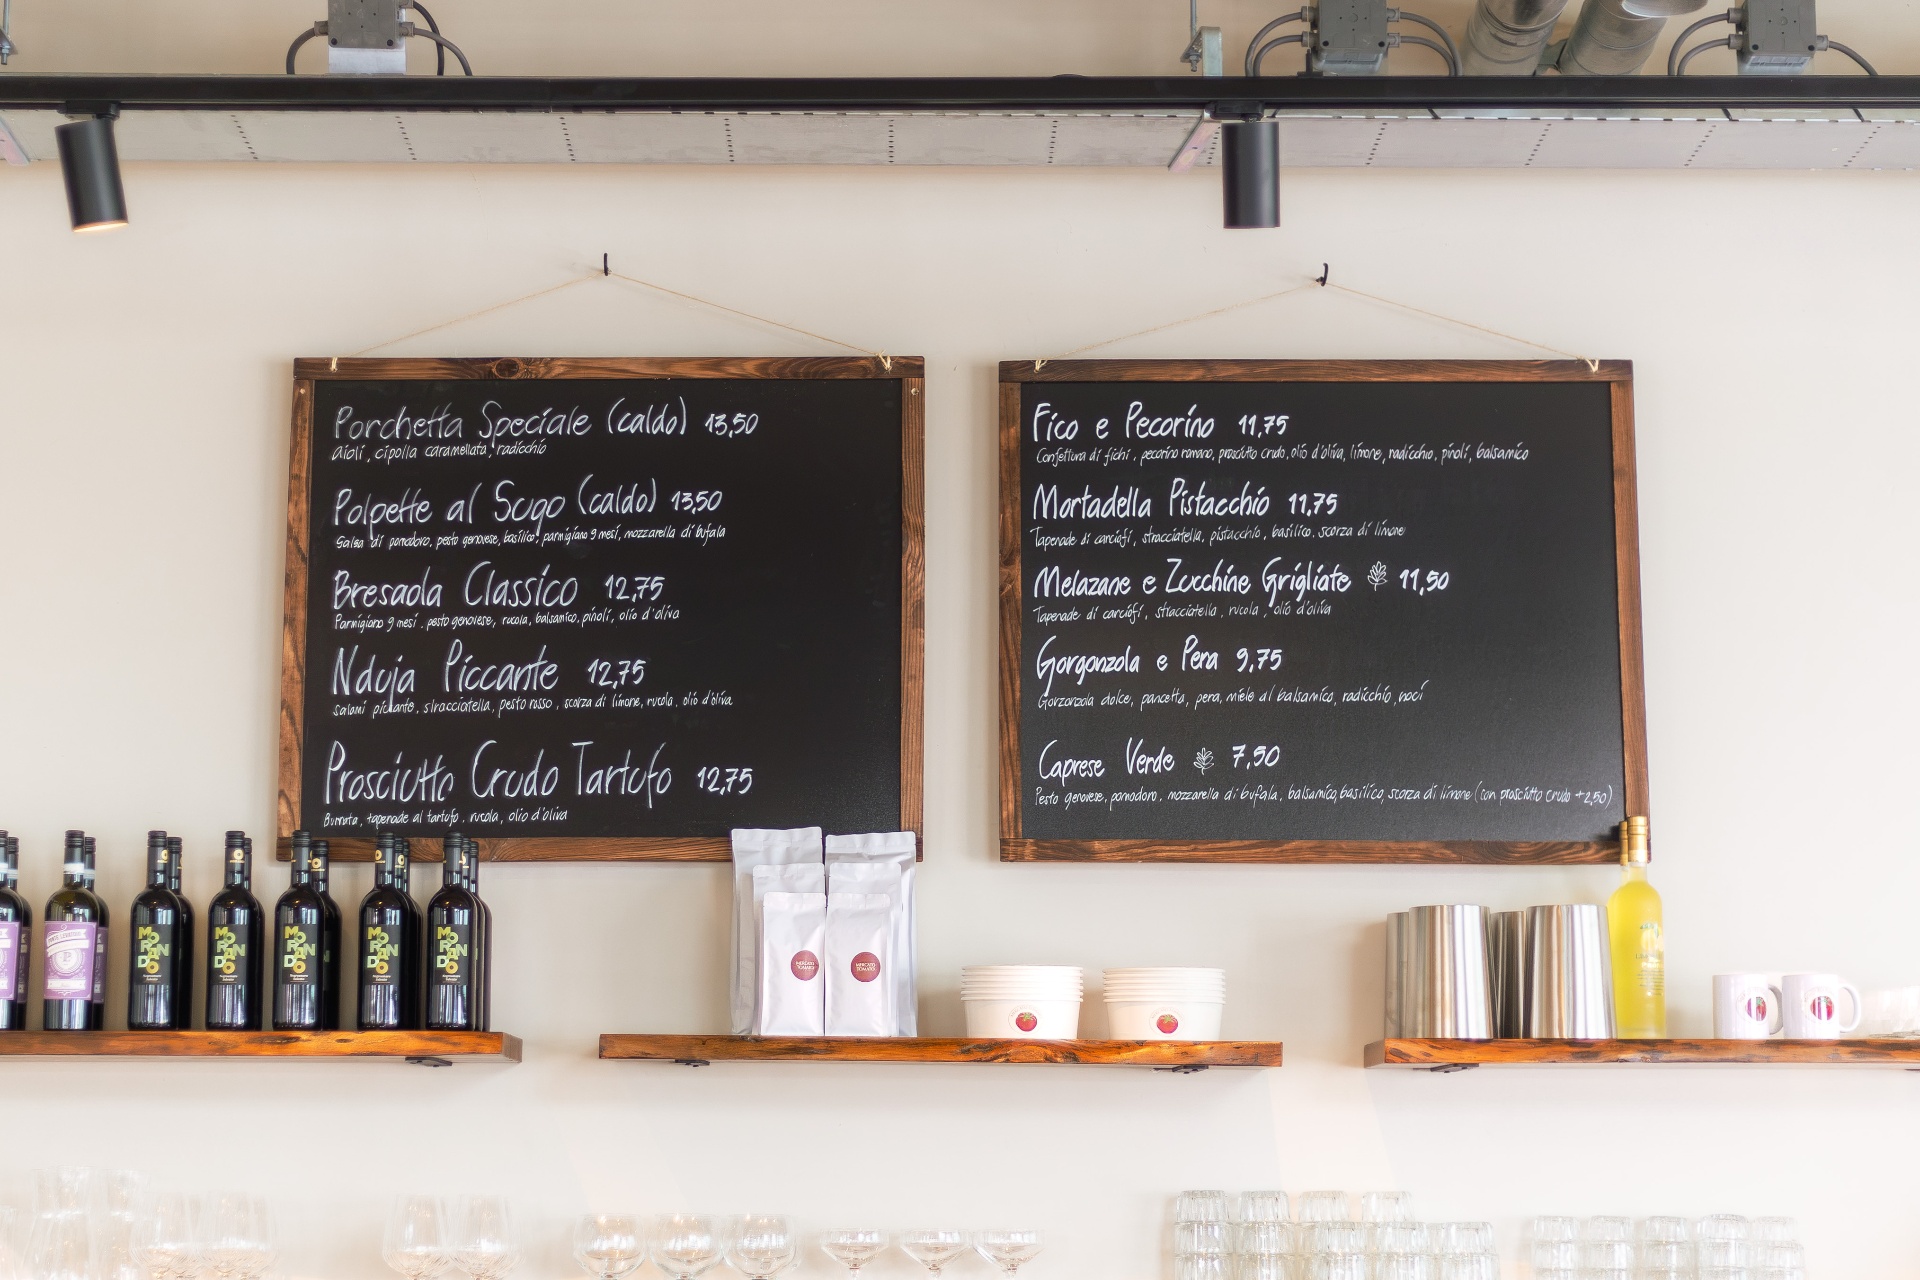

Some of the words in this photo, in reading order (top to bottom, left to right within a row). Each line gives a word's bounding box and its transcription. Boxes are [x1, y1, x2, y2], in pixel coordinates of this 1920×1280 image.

[335, 402, 462, 439] Porchetta
[479, 400, 592, 447] Speciale
[608, 396, 686, 435] (caldo)
[705, 413, 758, 437] 13,50
[1033, 402, 1079, 442] Fico
[1096, 418, 1109, 439] e
[1125, 401, 1215, 438] Pecorino
[1238, 414, 1289, 439] 11,75
[375, 445, 417, 465] cipolla
[496, 439, 547, 456] radicchio
[1036, 447, 1086, 467] Confettura
[1089, 447, 1102, 461] di
[1140, 445, 1178, 466] pecorino
[1218, 445, 1258, 464] prosciutto
[1290, 443, 1308, 459] olio
[1476, 441, 1529, 460] balsamico
[334, 488, 432, 540] Polpette
[447, 483, 482, 523] al
[494, 480, 565, 537] Sugo
[578, 473, 656, 514] (caldo)
[671, 490, 723, 514] 13,50
[1033, 483, 1151, 519] Mortadella
[1169, 477, 1270, 517] Pistacchio
[1288, 492, 1338, 517] 11,75
[371, 535, 384, 548] di
[435, 532, 458, 550] pesto
[542, 526, 587, 547] parmigiano
[590, 528, 597, 540] 9
[624, 525, 676, 539] mozzarella
[680, 523, 695, 538] di
[695, 523, 726, 547] bufala
[1029, 526, 1077, 552] Tapenade
[1081, 532, 1091, 546] di
[1318, 526, 1353, 538] scorza
[1357, 521, 1373, 536] di
[1374, 519, 1406, 537] limone
[333, 566, 443, 610] Bresaola
[464, 560, 578, 608] Classico
[605, 574, 667, 603] 12,75
[1034, 565, 1131, 598] Melazane
[1143, 575, 1156, 594] e
[1165, 558, 1251, 594] Zucchine
[1262, 556, 1351, 607] Grigliate
[1399, 568, 1450, 596] 11,50
[335, 613, 384, 633] Parmigiano
[426, 614, 450, 631] pesto
[619, 607, 638, 621] olio
[642, 605, 680, 621] d'oliva
[1033, 605, 1081, 626] Tapenade
[1086, 606, 1099, 620] di
[1274, 601, 1291, 616] olio
[1296, 599, 1331, 616] d'oliva
[442, 638, 559, 692] Piccante
[587, 658, 647, 690] 12,75
[1036, 635, 1140, 697] Gorgonzola
[1157, 655, 1168, 672] e
[1182, 635, 1219, 672] Pera
[1236, 647, 1282, 673] 9,75
[333, 700, 367, 717] salami
[498, 696, 526, 718] pesto
[564, 697, 592, 709] scorza
[595, 694, 606, 708] di
[683, 691, 698, 706] olio
[702, 690, 733, 706] d'oliva
[1226, 686, 1254, 702] miele
[1259, 684, 1276, 701] al
[1398, 680, 1429, 702] noci
[324, 740, 454, 804] Prosciutto
[472, 740, 559, 797] Crudo
[571, 740, 672, 809] Tartufo
[697, 766, 753, 795] 12,75
[1039, 739, 1105, 786] Caprese
[1126, 737, 1175, 774] Verde
[1232, 744, 1280, 770] 7,50
[1035, 786, 1058, 805] Pesto
[1168, 787, 1219, 800] mozzarella
[1224, 787, 1238, 800] di
[1388, 787, 1420, 800] scorza
[1423, 782, 1437, 800] di
[1440, 784, 1473, 800] limone
[1474, 780, 1496, 803] (con
[1499, 785, 1543, 806] prosciutto
[1545, 787, 1571, 802] crudo
[367, 809, 409, 829] tapenade
[413, 809, 422, 824] al
[508, 806, 528, 822] olio
[531, 805, 567, 821] d'oliva
